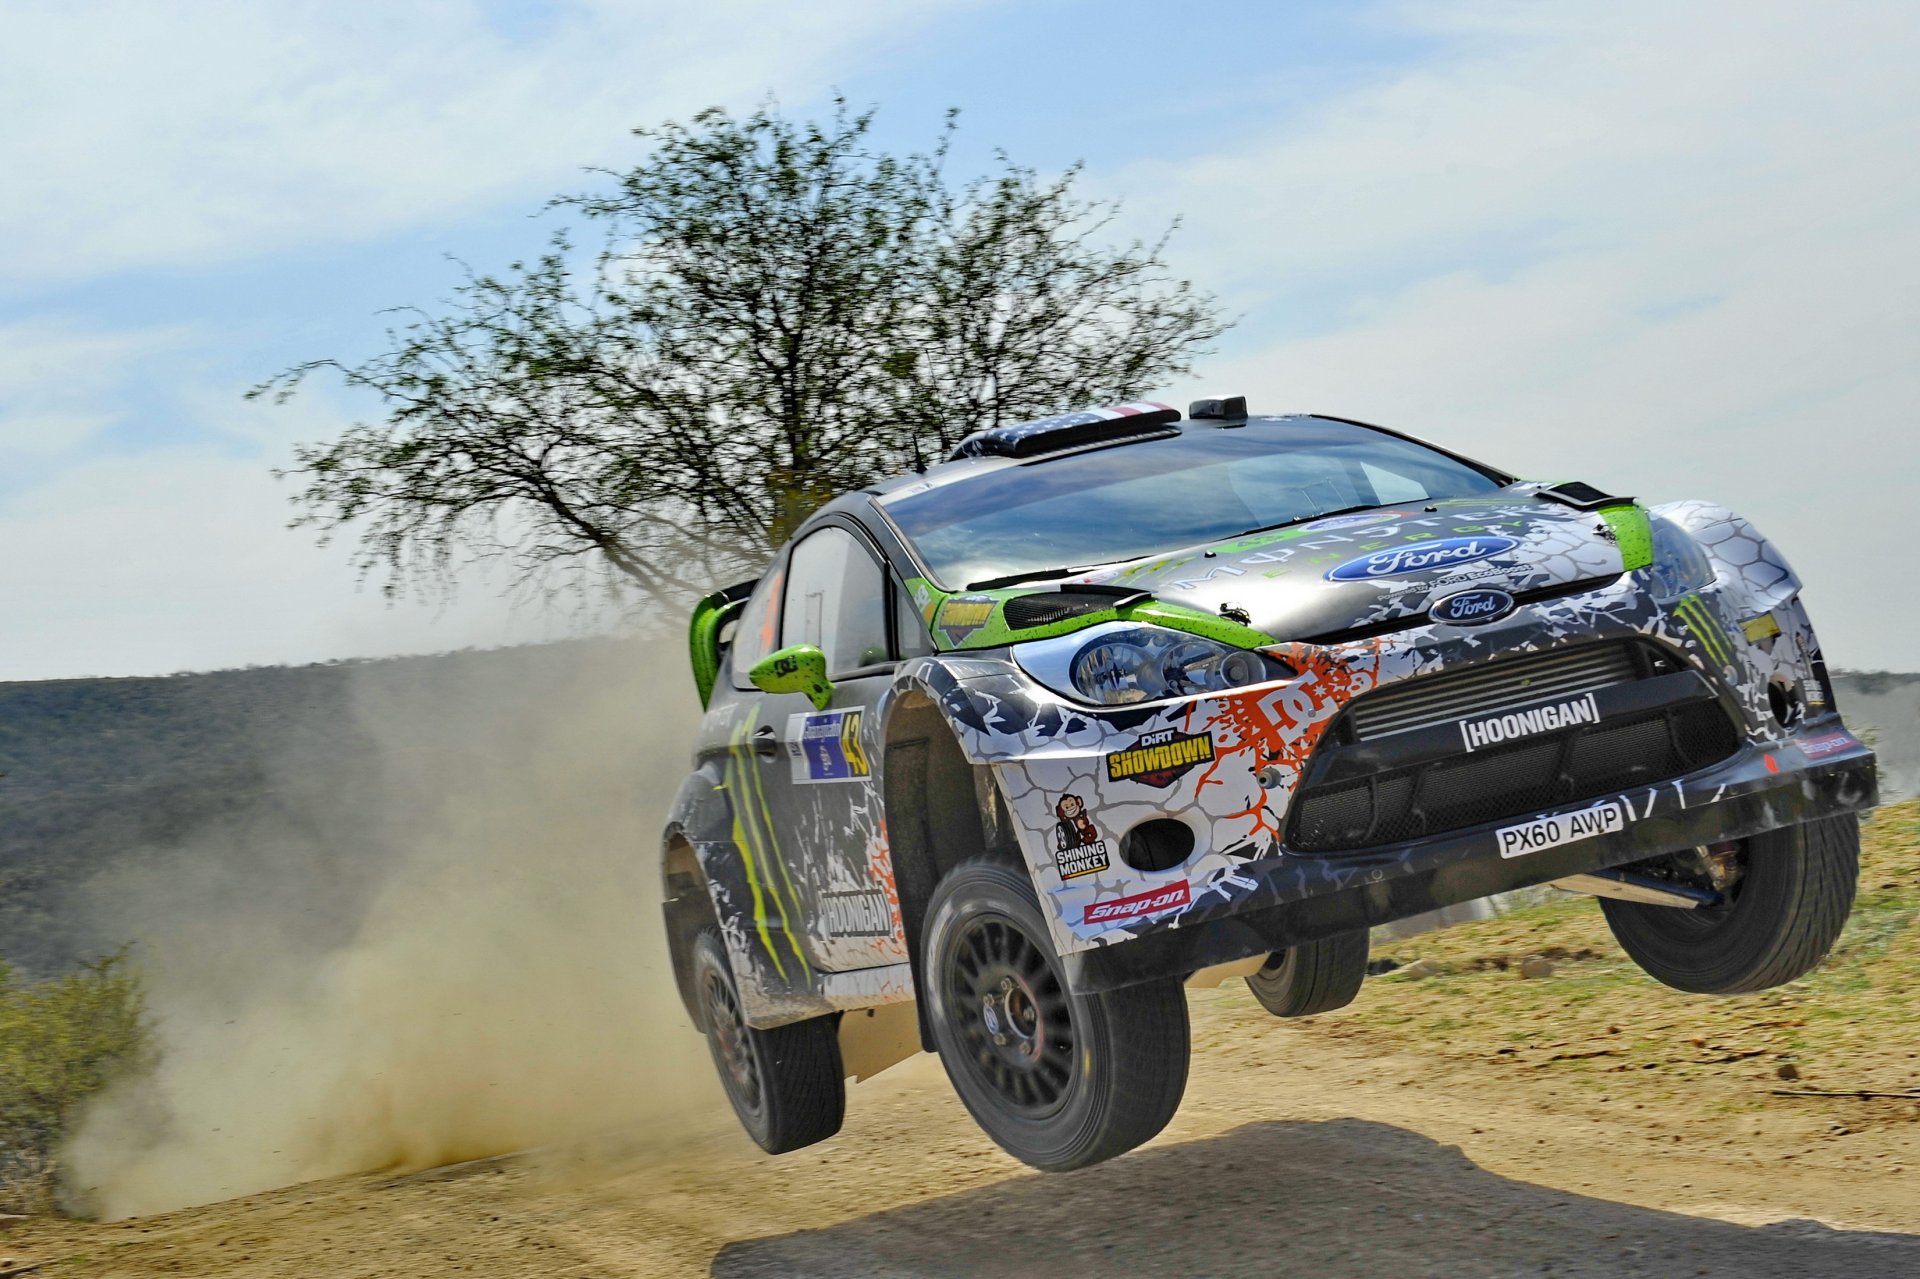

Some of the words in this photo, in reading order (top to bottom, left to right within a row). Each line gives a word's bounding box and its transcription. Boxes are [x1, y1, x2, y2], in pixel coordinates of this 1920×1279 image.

[1367, 541, 1487, 574] Ford
[1378, 586, 1416, 601] Powered
[1416, 581, 1430, 593] by
[1430, 574, 1467, 589] FORD
[1468, 564, 1534, 580] EcoBoost
[1451, 594, 1496, 618] Ford
[1257, 669, 1340, 745] DC
[842, 713, 869, 775] 43
[1109, 735, 1211, 778] SHOWDOWN
[1503, 820, 1561, 853] PX60
[1570, 807, 1618, 838] AWP
[1056, 842, 1106, 864] SHINING
[1059, 854, 1107, 876] MONKEY
[1087, 889, 1185, 919] Snap-on
